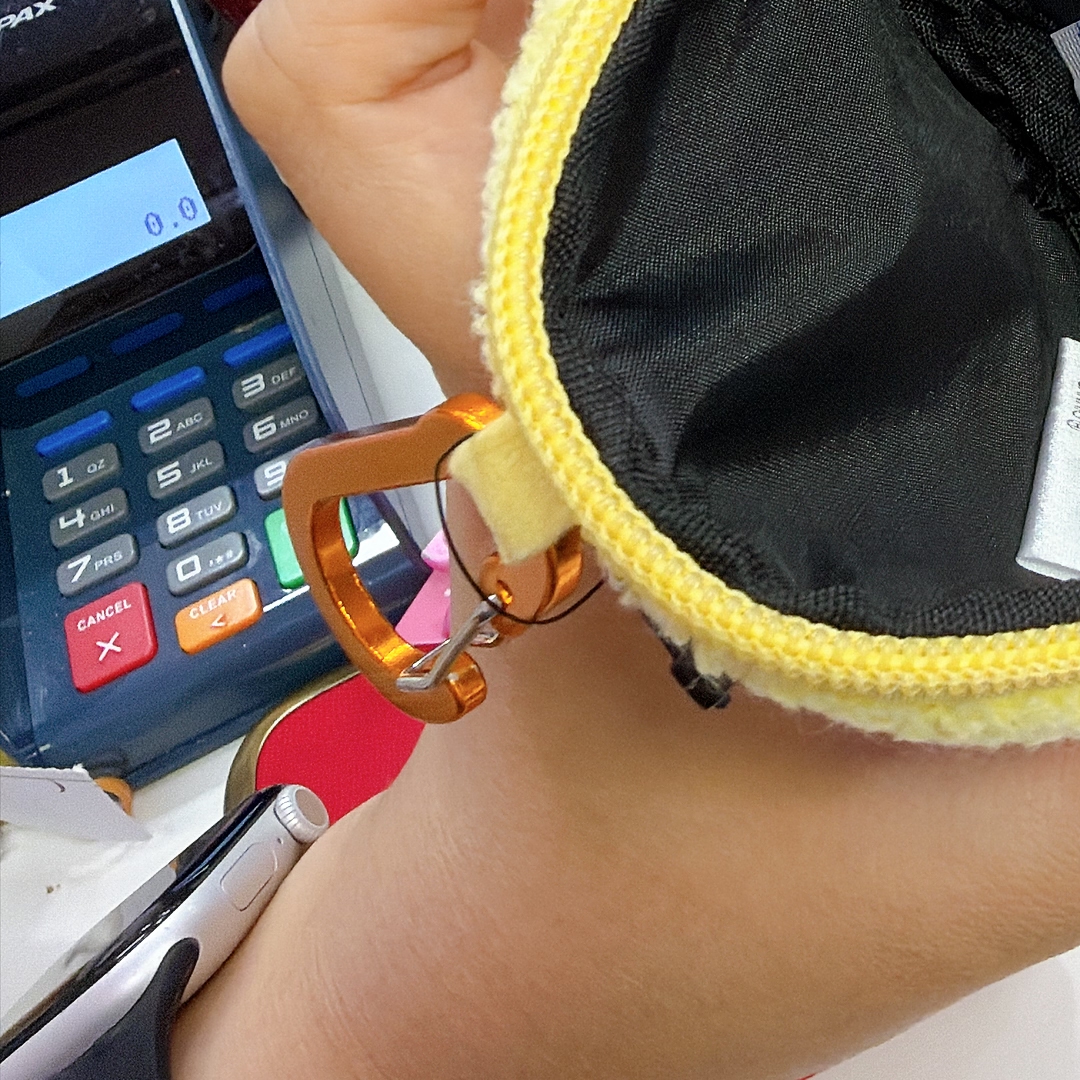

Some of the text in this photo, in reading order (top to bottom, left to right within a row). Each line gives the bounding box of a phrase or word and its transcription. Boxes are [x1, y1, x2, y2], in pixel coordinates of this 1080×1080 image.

[144, 196, 198, 236] 0.0
[242, 367, 297, 399] 3 DEF
[147, 412, 203, 445] 2 ABC
[252, 409, 309, 441] 6 MNO
[57, 459, 105, 488] 1 QZ
[156, 457, 213, 489] 5 JKL
[264, 460, 287, 487] 9
[58, 503, 115, 529] 4 GHI
[166, 501, 223, 534] 8 TUV
[67, 551, 123, 582] 7 PRS
[176, 555, 201, 582] 0
[76, 599, 132, 632] CANCEL
[189, 589, 238, 620] CLEAR
